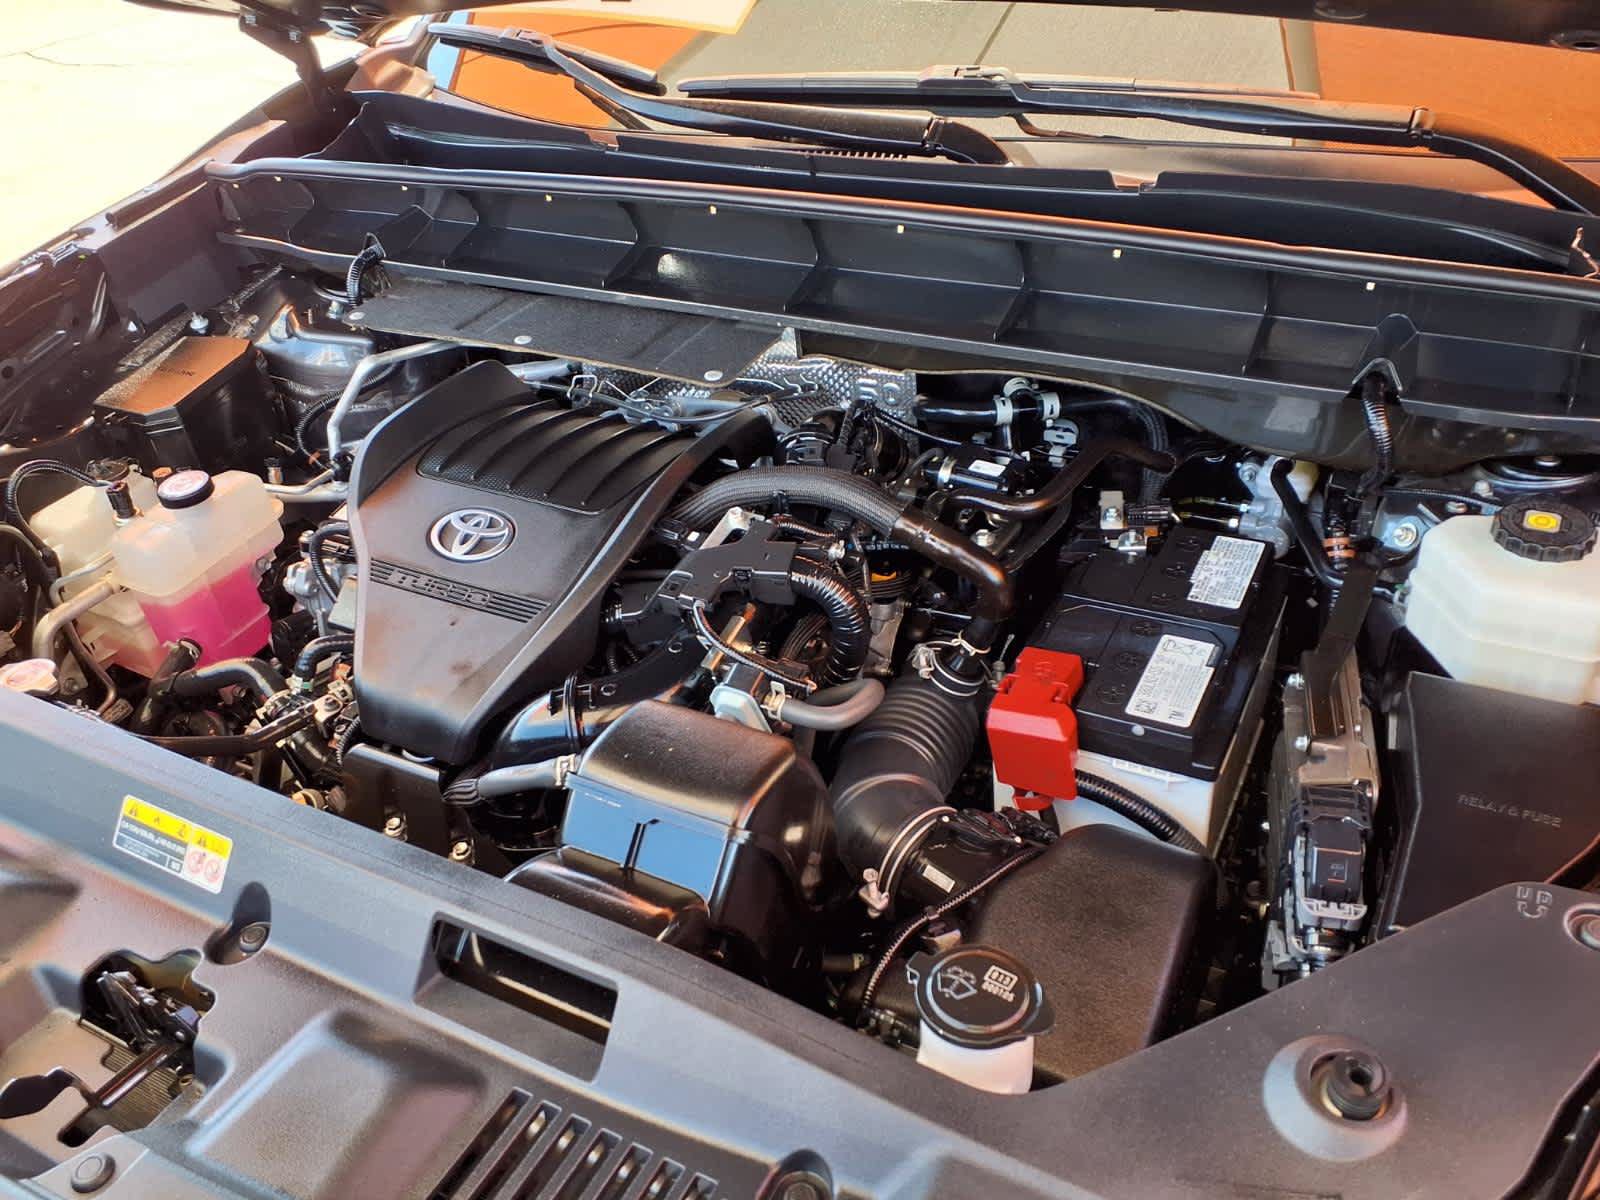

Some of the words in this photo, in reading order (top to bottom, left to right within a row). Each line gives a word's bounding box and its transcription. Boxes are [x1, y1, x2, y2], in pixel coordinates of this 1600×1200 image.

[391, 567, 490, 606] TURBO
[1458, 794, 1507, 813] RELAY
[1521, 809, 1562, 828] FUSE
